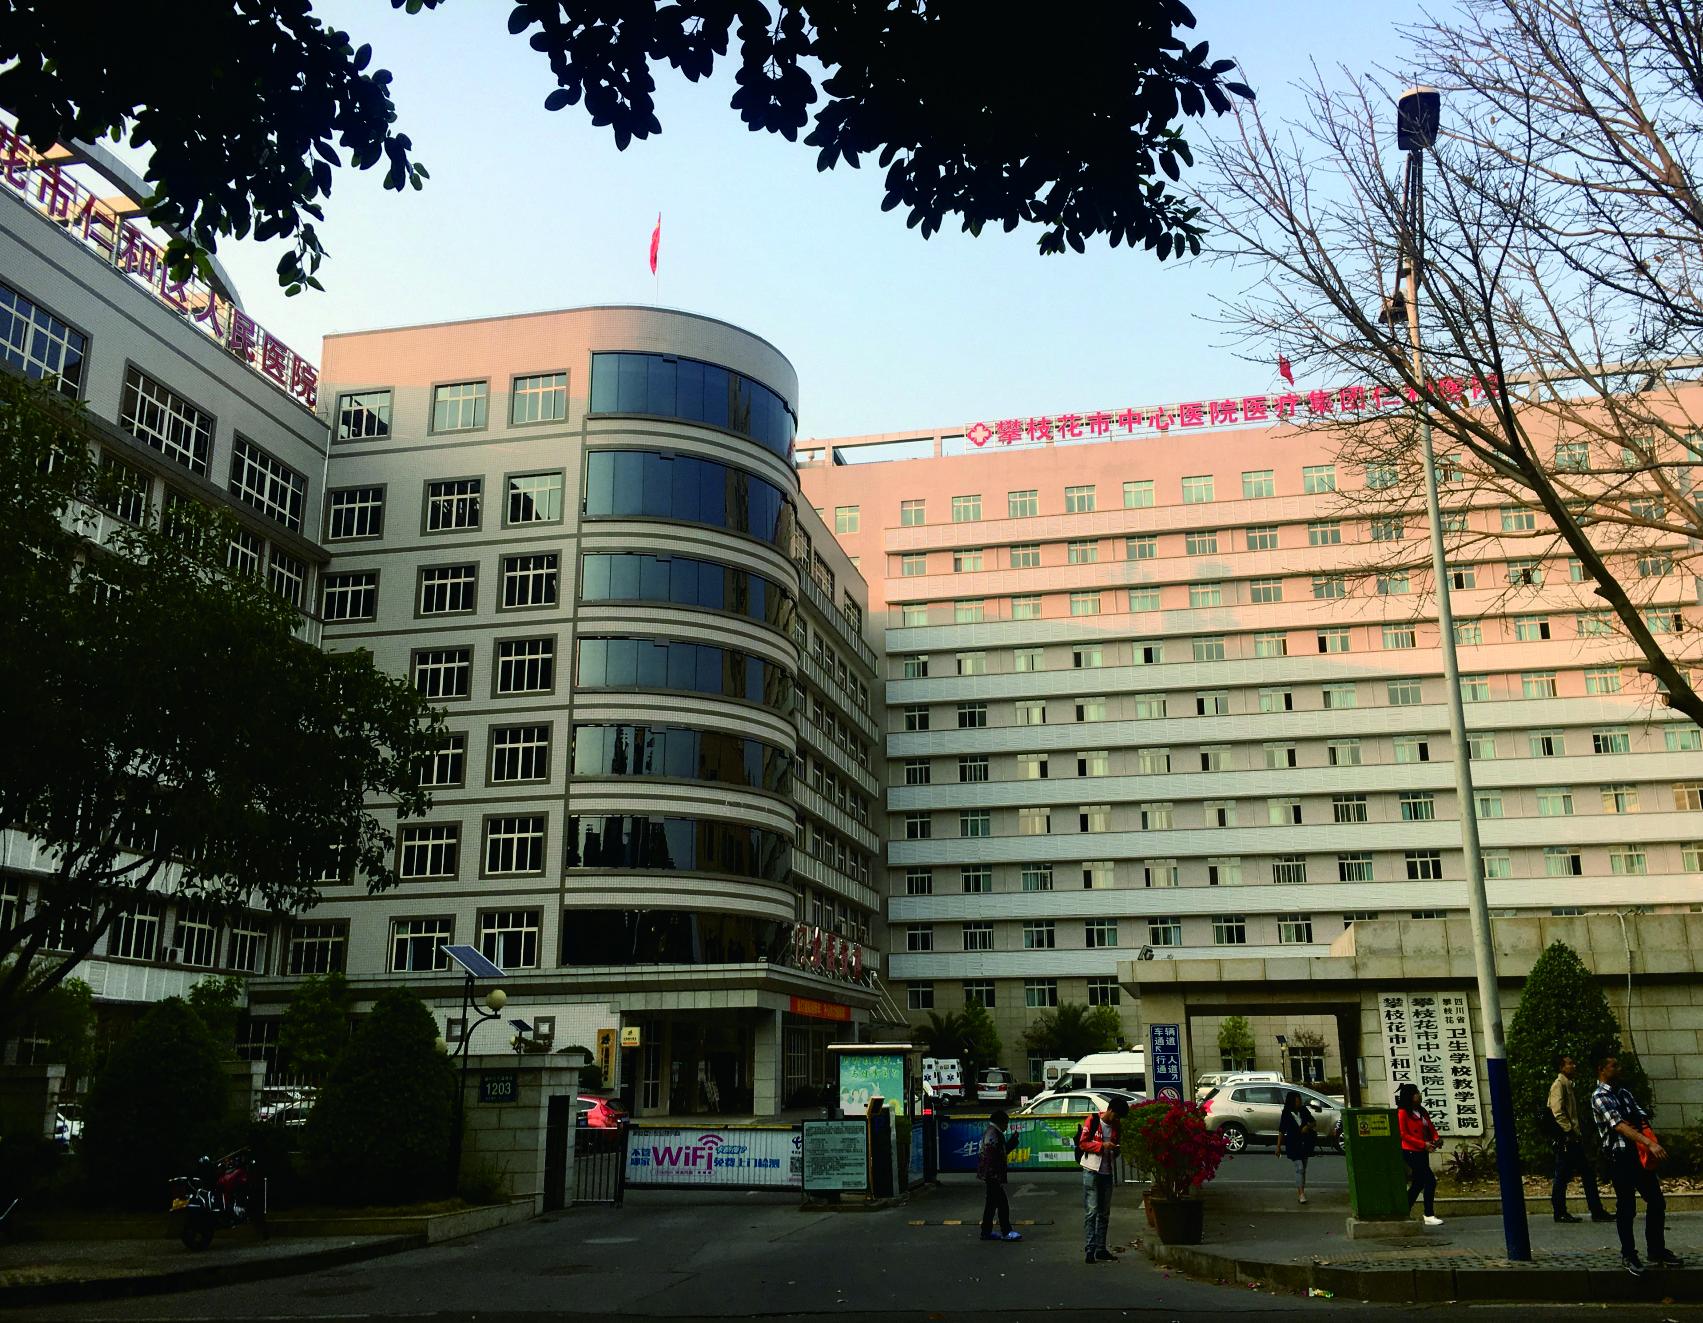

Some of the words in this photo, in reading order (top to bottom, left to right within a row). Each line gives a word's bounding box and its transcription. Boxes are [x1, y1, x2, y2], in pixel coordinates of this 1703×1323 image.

[1454, 998, 1465, 1024] 四川省
[486, 1082, 512, 1096] 1203
[1446, 1028, 1479, 1129] 卫生学校教学医院
[652, 1146, 714, 1171] WiFi
